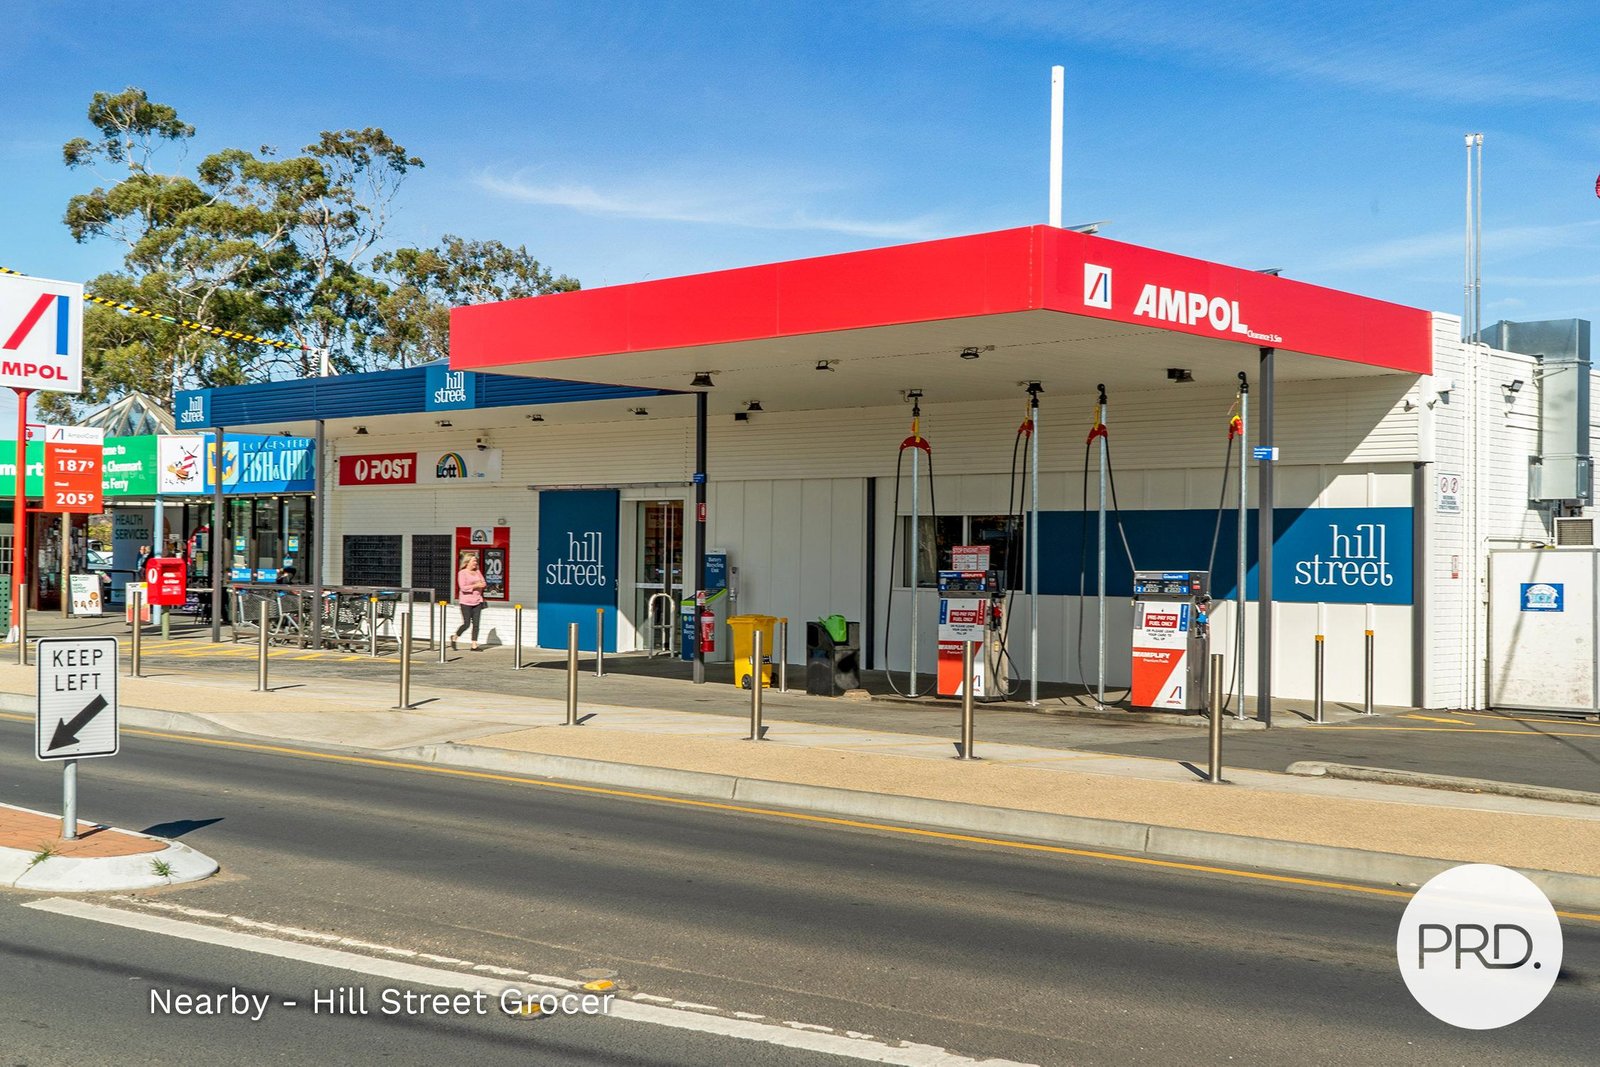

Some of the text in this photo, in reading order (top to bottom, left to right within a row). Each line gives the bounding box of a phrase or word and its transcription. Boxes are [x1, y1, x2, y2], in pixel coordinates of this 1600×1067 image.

[1133, 284, 1248, 334] AMPOL
[445, 371, 464, 390] hill
[188, 396, 203, 411] hill
[434, 387, 467, 403] street
[181, 409, 205, 423] street
[0, 462, 44, 476] mrt
[242, 451, 274, 482] FISH
[370, 457, 413, 479] POST
[436, 464, 458, 479] Lott
[115, 514, 144, 526] HEALTH
[115, 529, 150, 540] SERVICES
[1329, 524, 1386, 559] hill
[567, 531, 603, 562] hill
[546, 557, 606, 586] street
[1294, 554, 1394, 587] street
[53, 649, 103, 668] KEEP
[55, 673, 101, 692] LEFT
